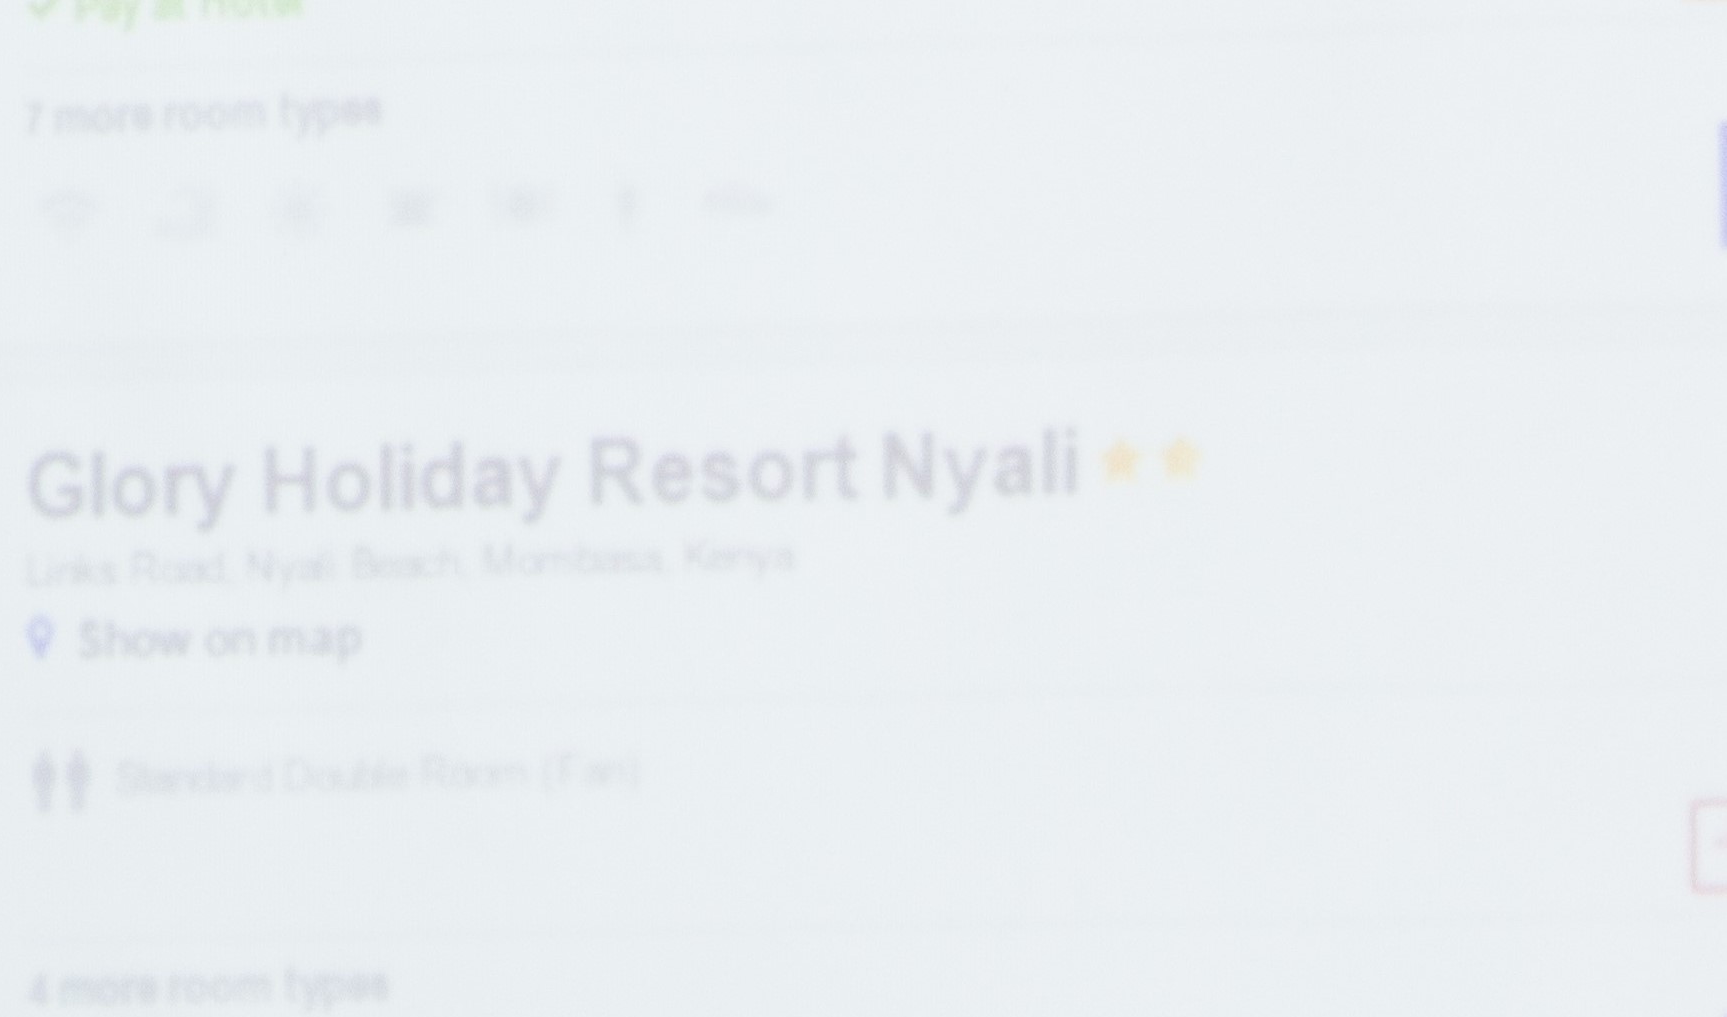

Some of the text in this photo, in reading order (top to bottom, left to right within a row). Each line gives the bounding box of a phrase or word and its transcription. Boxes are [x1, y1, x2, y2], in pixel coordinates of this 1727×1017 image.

[54, 103, 153, 134] more
[163, 100, 266, 131] room
[278, 93, 382, 140] types
[25, 423, 1080, 536] Glory Holiday Resort Nyali
[80, 617, 362, 664] Show on map
[58, 973, 158, 1006] more
[167, 970, 273, 1005] room
[284, 964, 389, 1014] types
